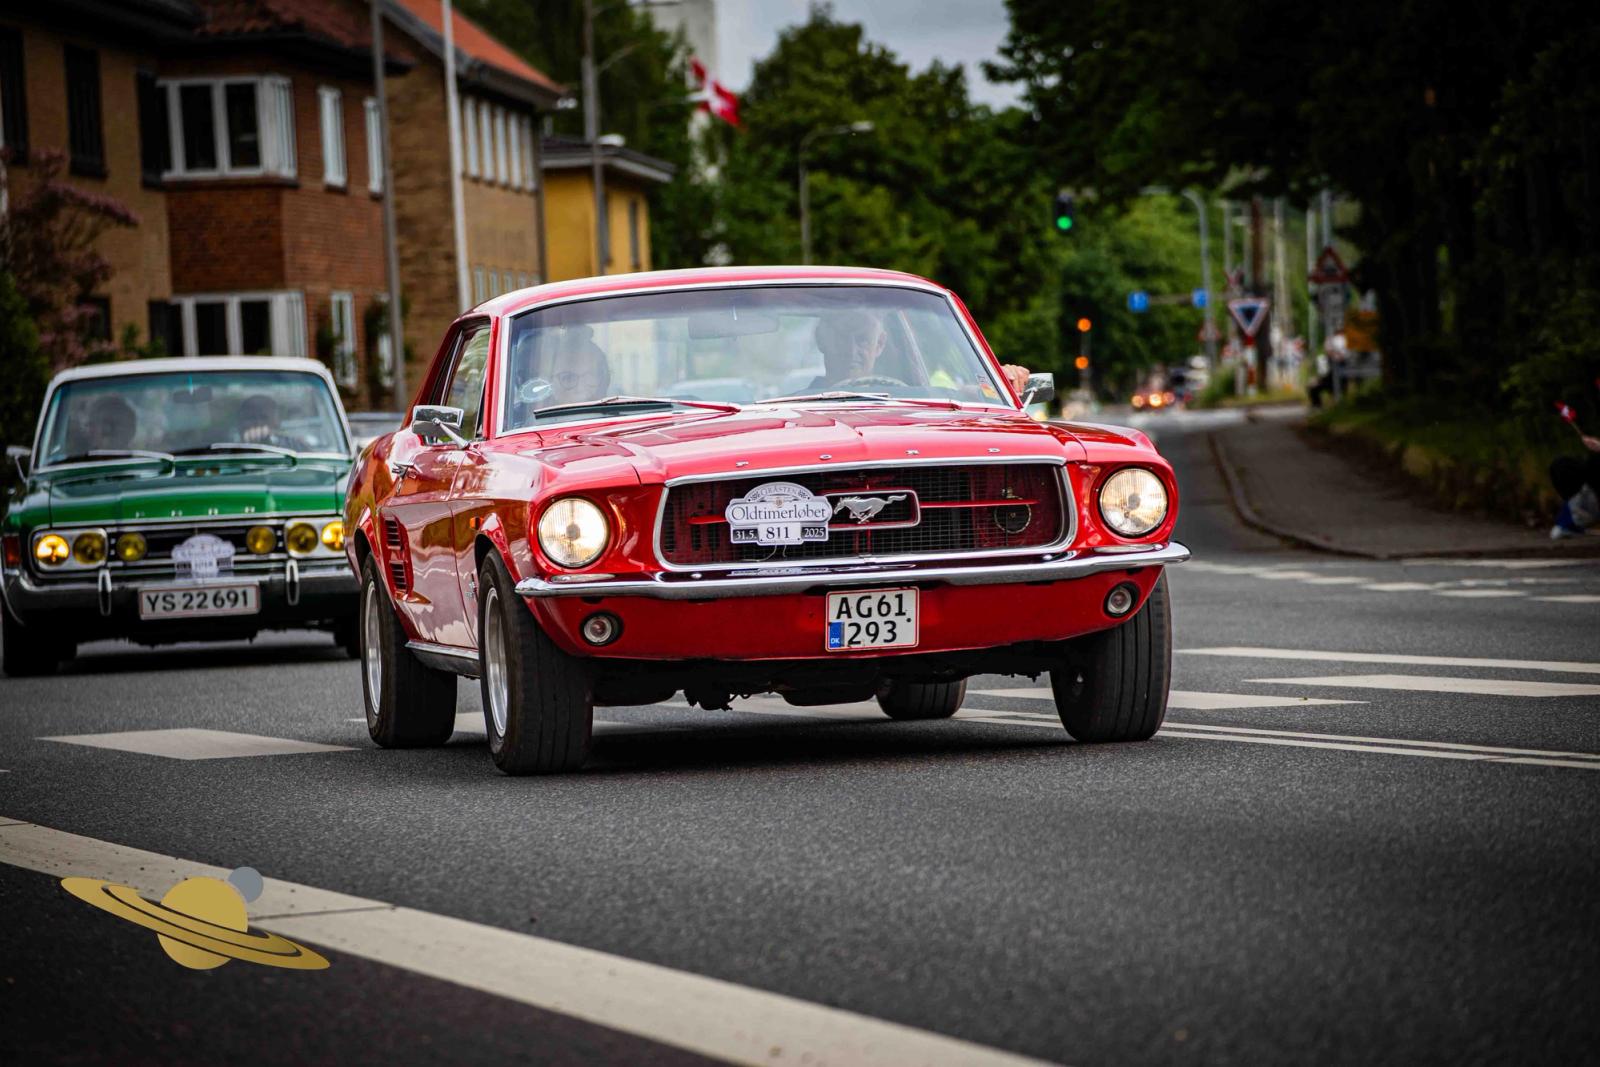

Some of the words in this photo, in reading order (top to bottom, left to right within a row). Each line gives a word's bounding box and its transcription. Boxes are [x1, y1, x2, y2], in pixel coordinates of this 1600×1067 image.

[731, 503, 826, 520] Oldtimerløbet
[735, 529, 758, 540] 31.5.
[766, 526, 790, 539] 811
[804, 528, 825, 538] 2025
[146, 592, 176, 613] YS
[835, 593, 906, 619] AG61
[847, 620, 898, 646] 293
